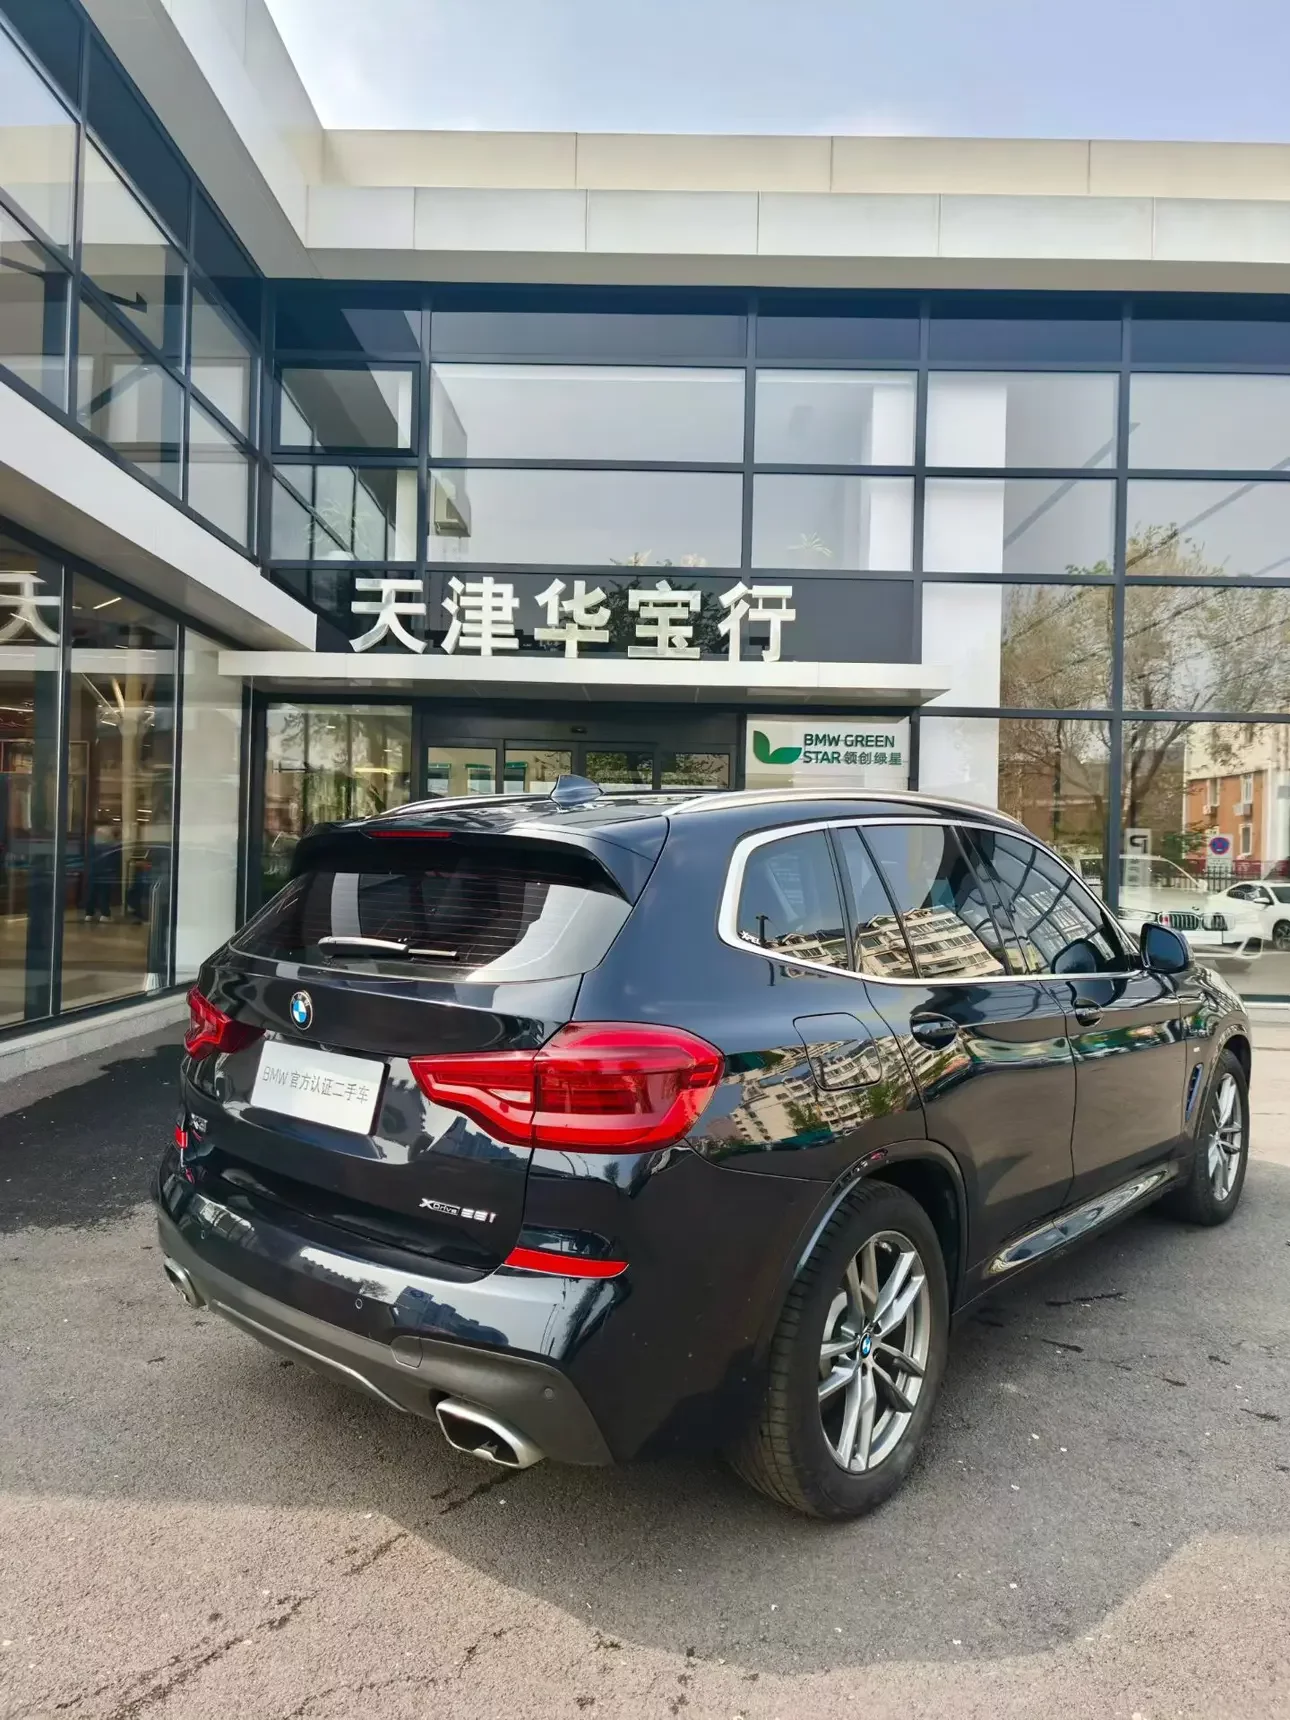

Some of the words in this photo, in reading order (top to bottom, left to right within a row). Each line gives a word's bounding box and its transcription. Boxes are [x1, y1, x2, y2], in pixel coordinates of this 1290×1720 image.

[349, 576, 797, 663] 天津华宝行
[803, 733, 841, 747] BMW
[844, 734, 895, 748] GREEN
[802, 751, 841, 764] STAR
[843, 751, 902, 766] 领创绿星
[262, 1066, 290, 1086] BMW
[289, 1071, 370, 1104] 官方认证二手车
